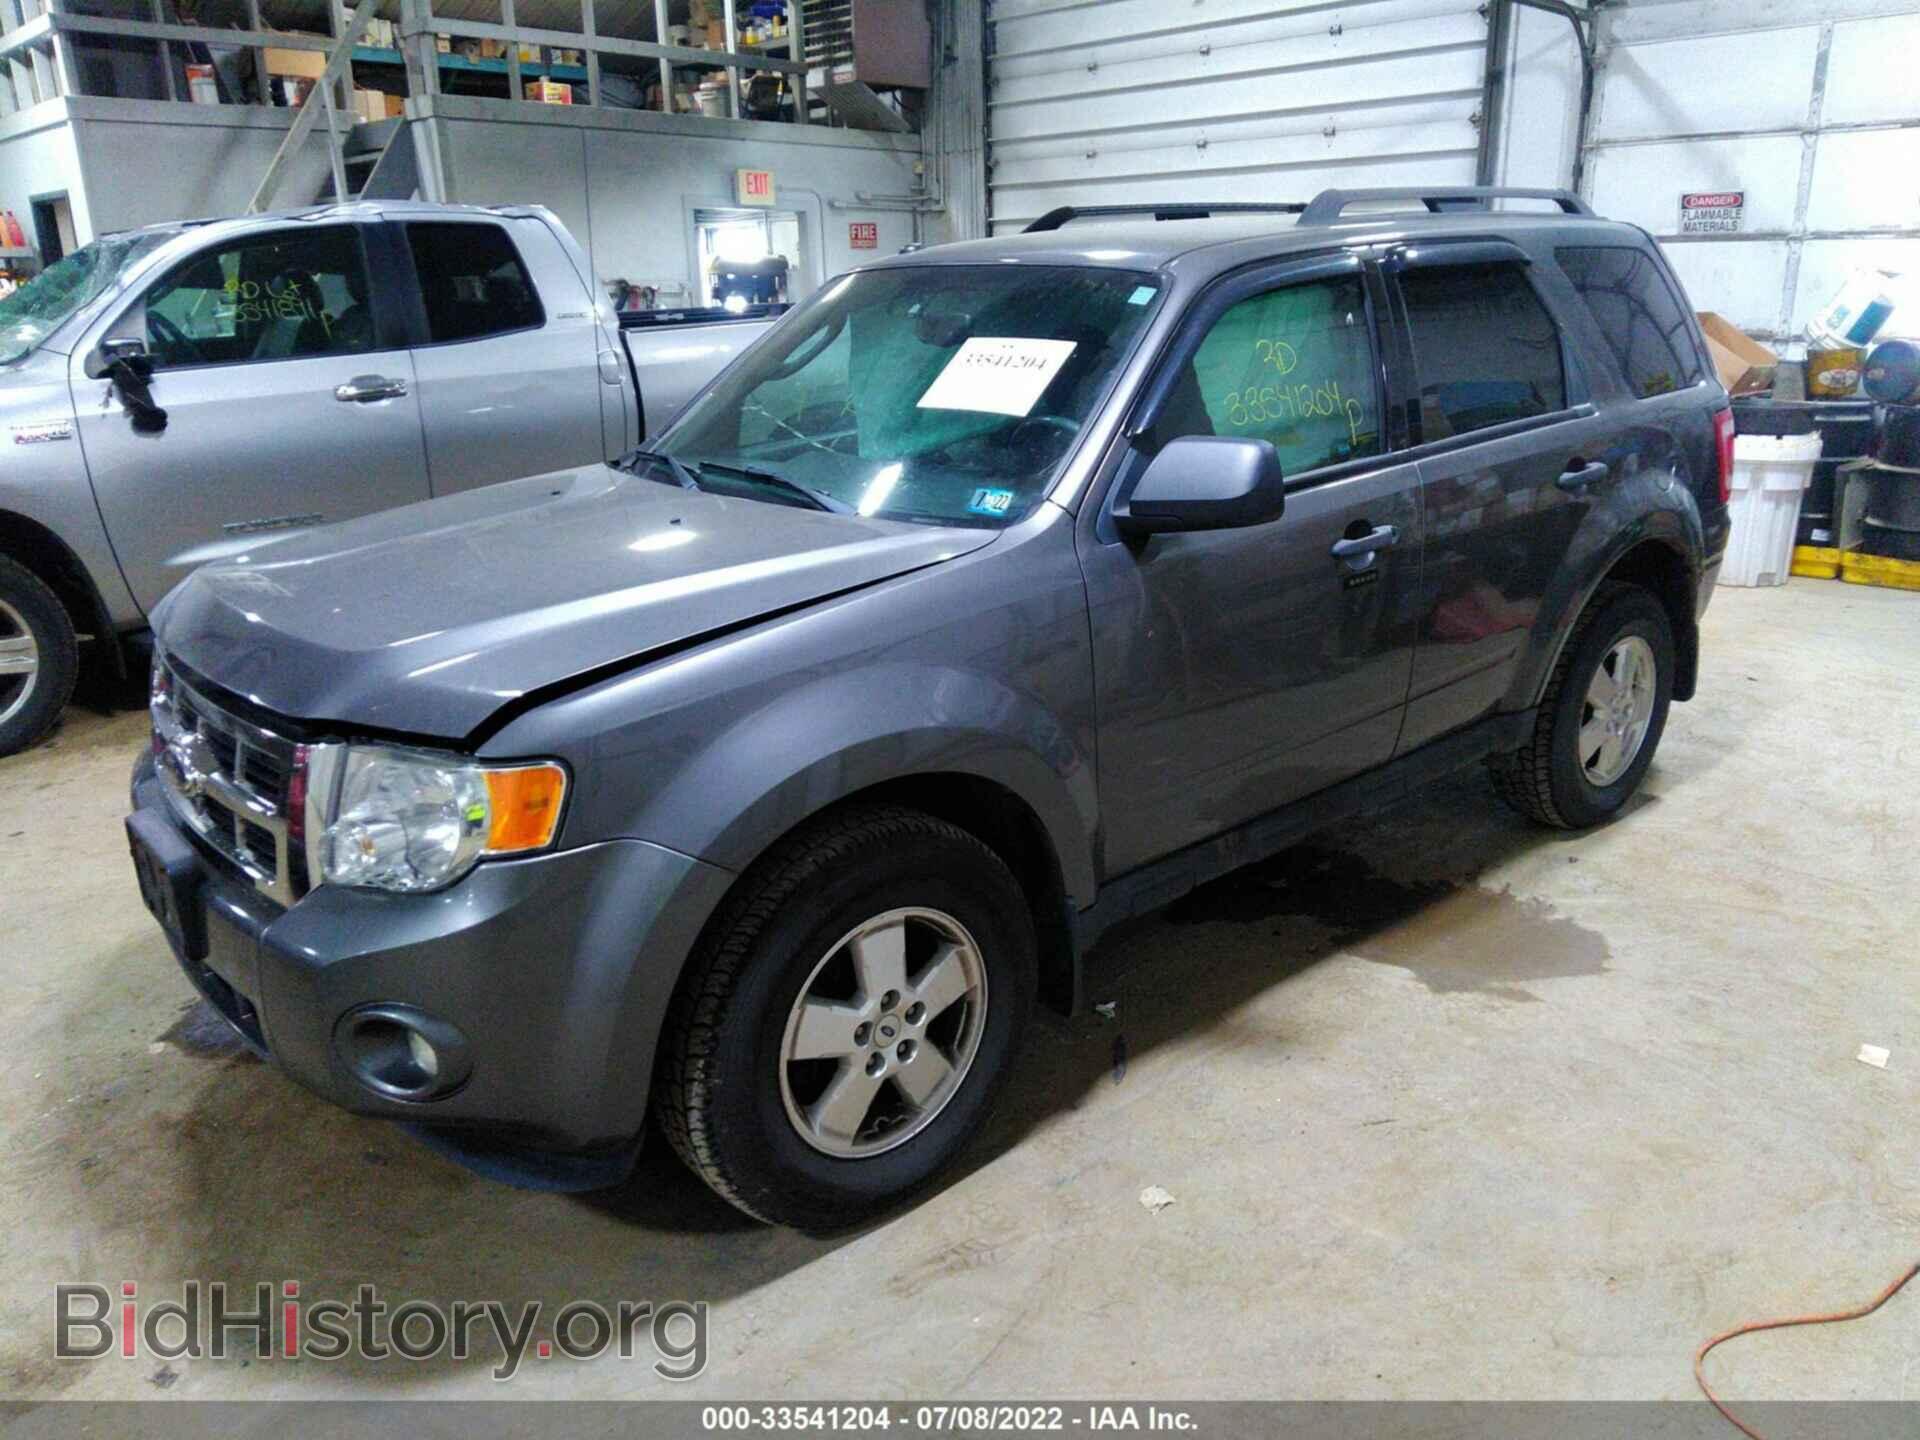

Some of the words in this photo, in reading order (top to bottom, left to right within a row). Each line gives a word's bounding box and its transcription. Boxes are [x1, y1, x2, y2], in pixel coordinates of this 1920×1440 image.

[746, 172, 769, 194] EXIT
[1691, 195, 1733, 206] DANGER
[1682, 209, 1742, 220] FLAMMABLE
[851, 224, 876, 239] FIRE
[1683, 220, 1738, 232] MATERIALS
